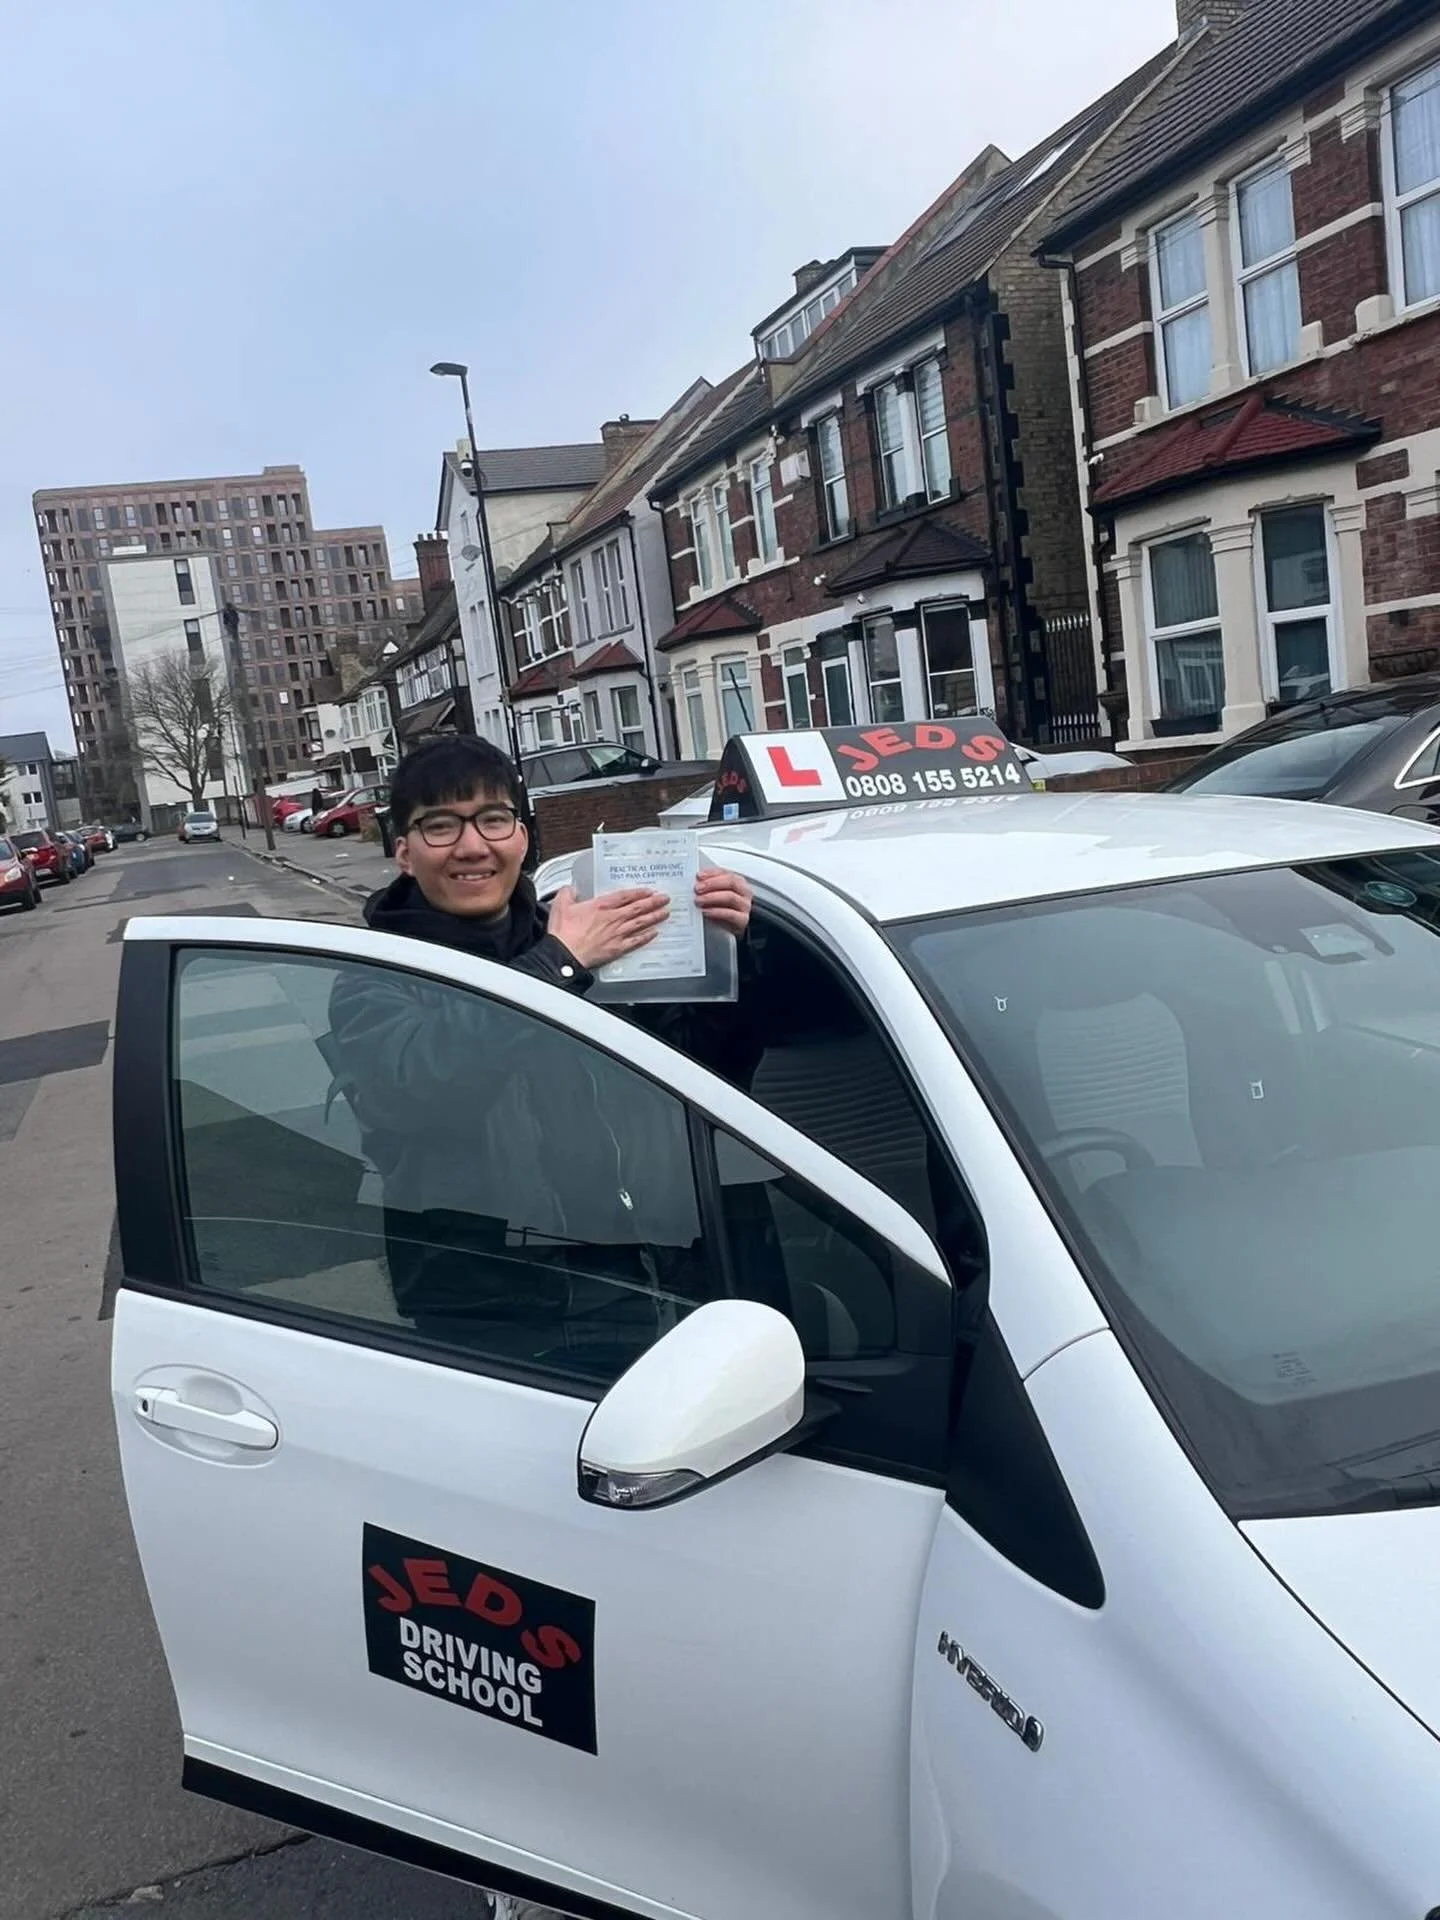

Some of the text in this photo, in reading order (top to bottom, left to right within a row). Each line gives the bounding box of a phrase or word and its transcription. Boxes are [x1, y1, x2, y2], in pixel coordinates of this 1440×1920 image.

[766, 746, 822, 787] L
[837, 725, 1005, 772] JEDS
[846, 762, 1021, 799] 0808 155 5214
[609, 863, 684, 873] PRACTICAL DRIVING
[642, 870, 684, 878] CERTIFICATE
[368, 1558, 583, 1669] JEDS
[399, 1616, 543, 1695] DRIVING
[402, 1650, 543, 1728] SCHOOL
